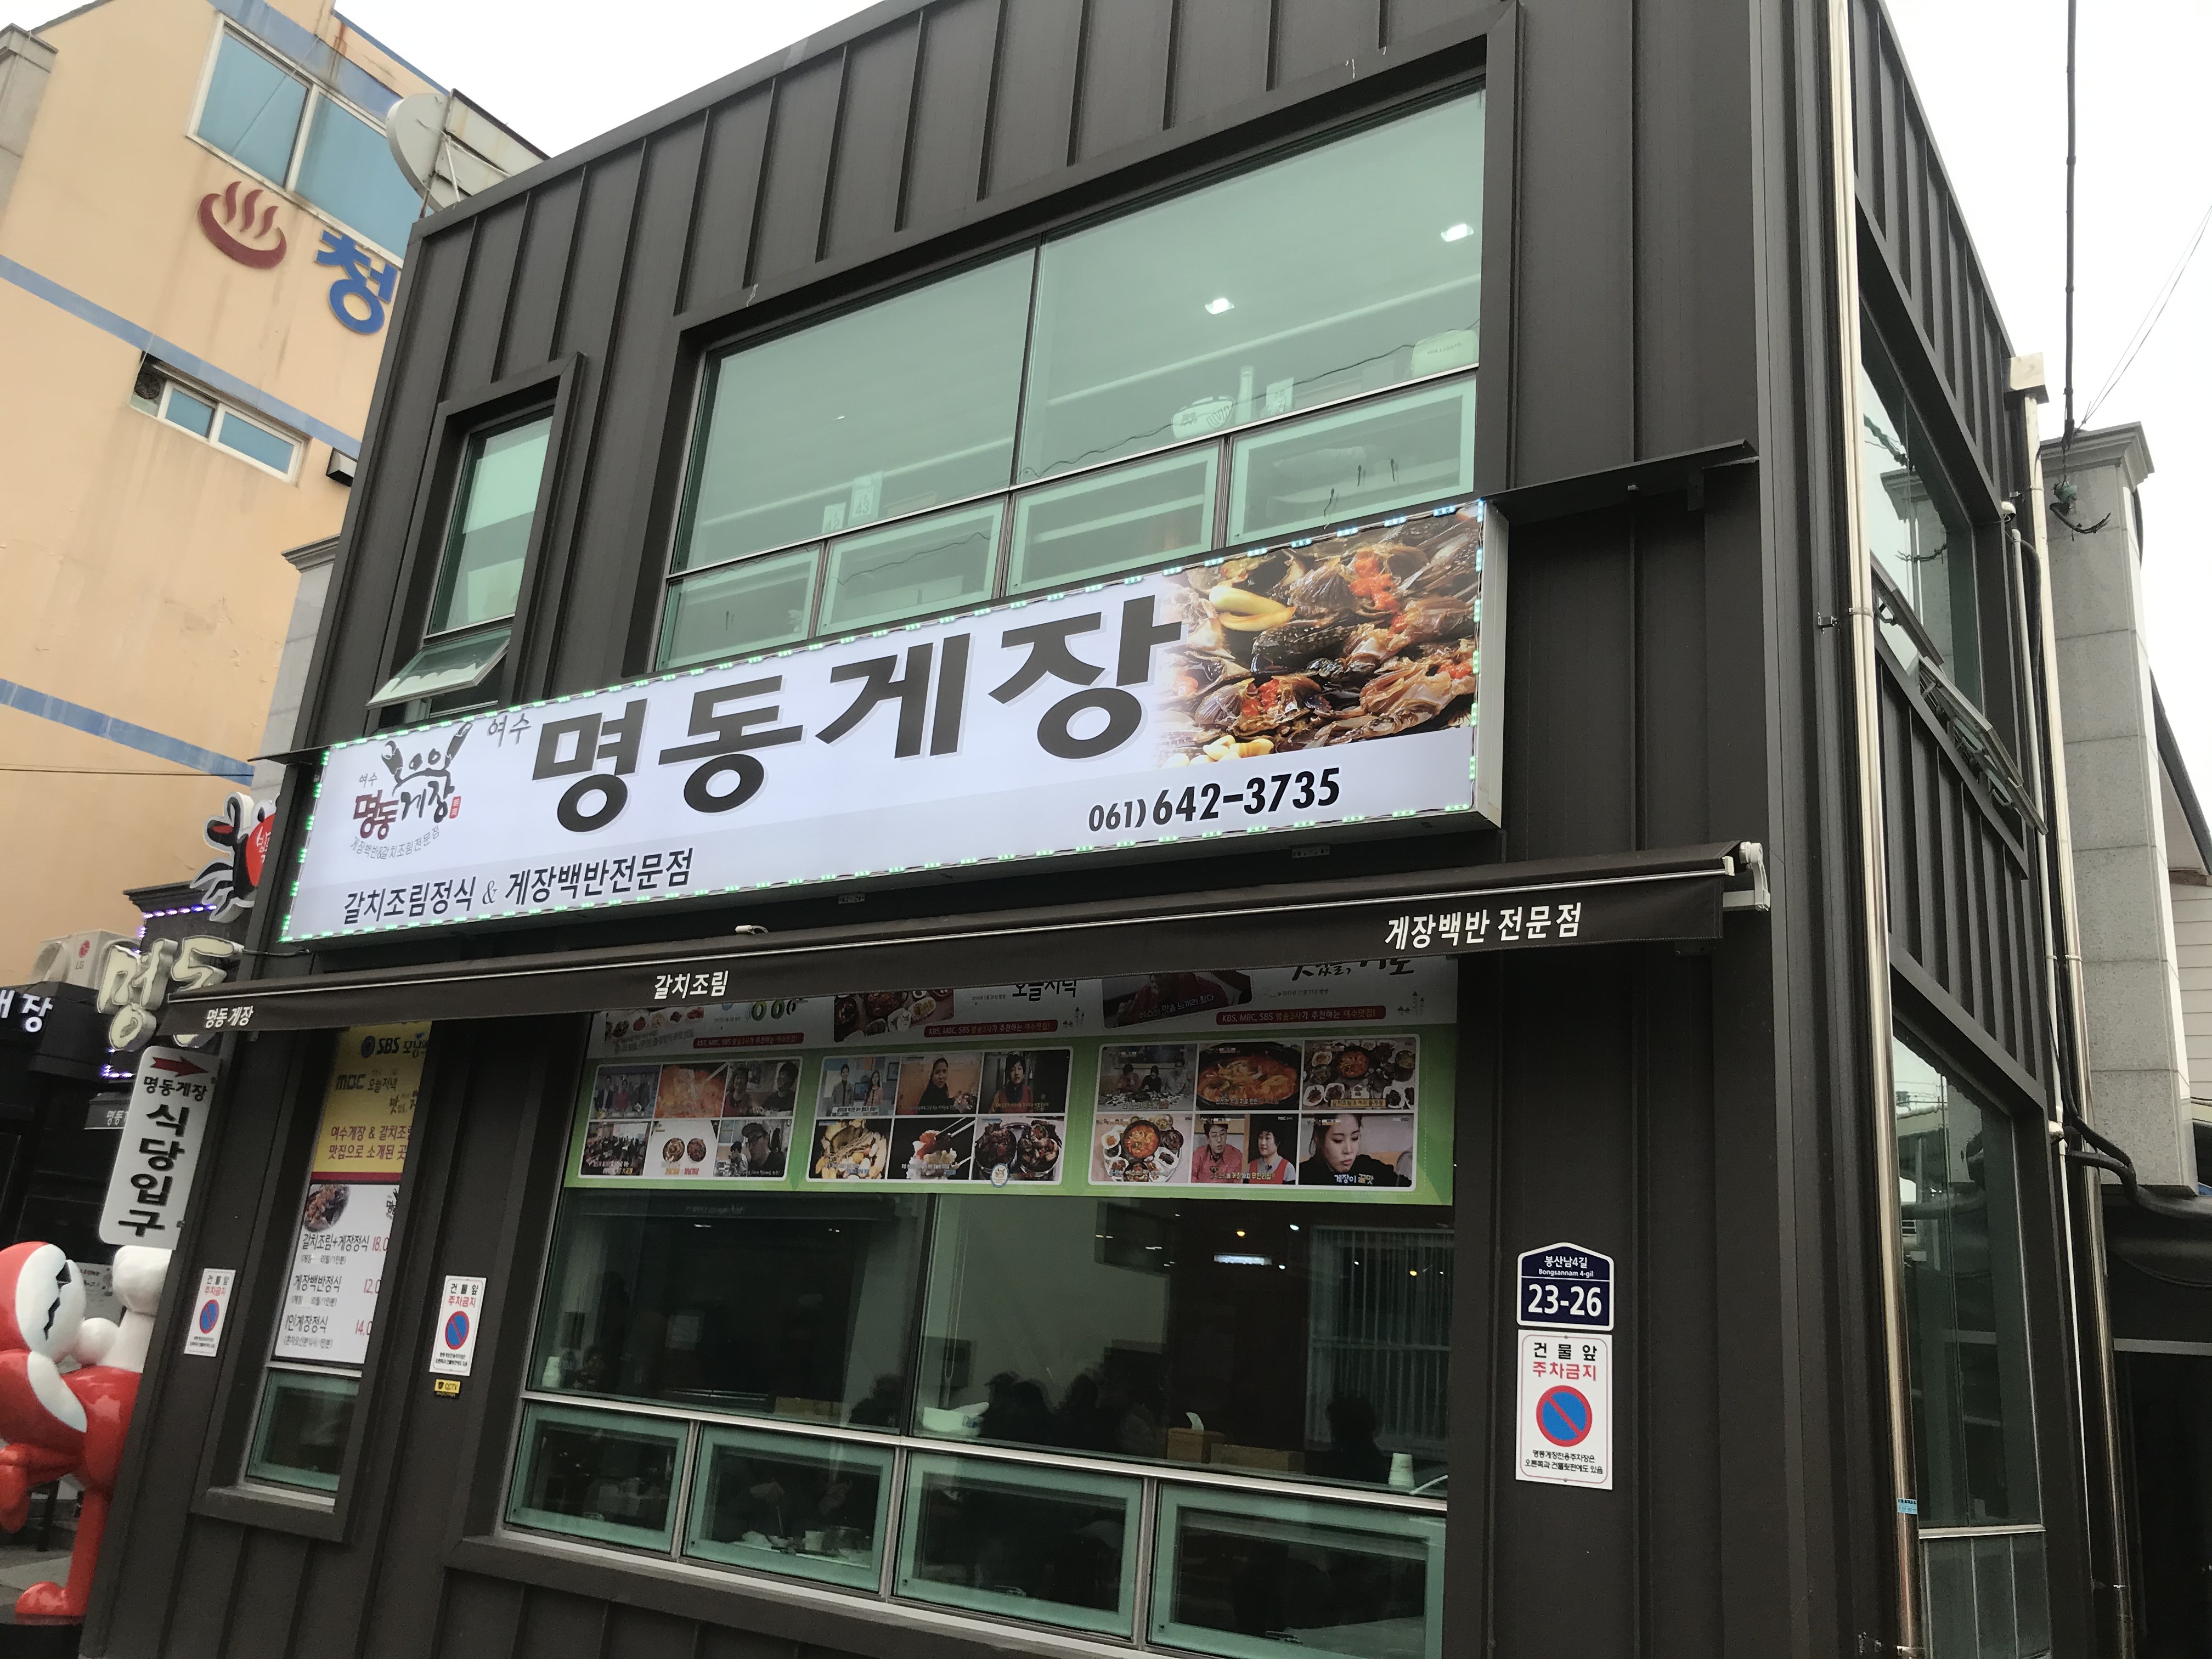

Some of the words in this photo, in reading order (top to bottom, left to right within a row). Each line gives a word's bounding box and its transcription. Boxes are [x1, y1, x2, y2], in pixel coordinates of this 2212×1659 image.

[314, 229, 398, 335] 청
[855, 500, 870, 515] 43
[488, 715, 531, 748] 여수
[531, 595, 1182, 833] 명동게장
[359, 772, 377, 788] 여수
[344, 876, 476, 924] 갈치조림정식
[482, 879, 499, 905] &
[505, 848, 693, 907] 게장백반전문점
[1385, 909, 1490, 950] 게장백반
[1498, 902, 1582, 941] 전문점
[654, 970, 729, 1000] 갈치조림
[205, 1005, 254, 1028] 명동게장
[1260, 1012, 1273, 1021] SBS
[1311, 1009, 1341, 1020] 추천하는
[376, 1037, 402, 1056] SBS
[403, 1040, 428, 1058] 모닝
[144, 1076, 208, 1102] 명동게장
[335, 1074, 366, 1091] MBC
[106, 1110, 129, 1126] 명동
[118, 1104, 190, 1238] 식당입구
[1544, 1255, 1588, 1269] 봉산남4길
[1538, 1268, 1578, 1277] Bongsannam
[1579, 1270, 1594, 1278] 4-gil
[294, 1274, 342, 1293] 게장백반정식
[448, 1295, 477, 1308] 주차금지
[1528, 1284, 1602, 1317] 23-26
[1533, 1361, 1596, 1381] 주차금지
